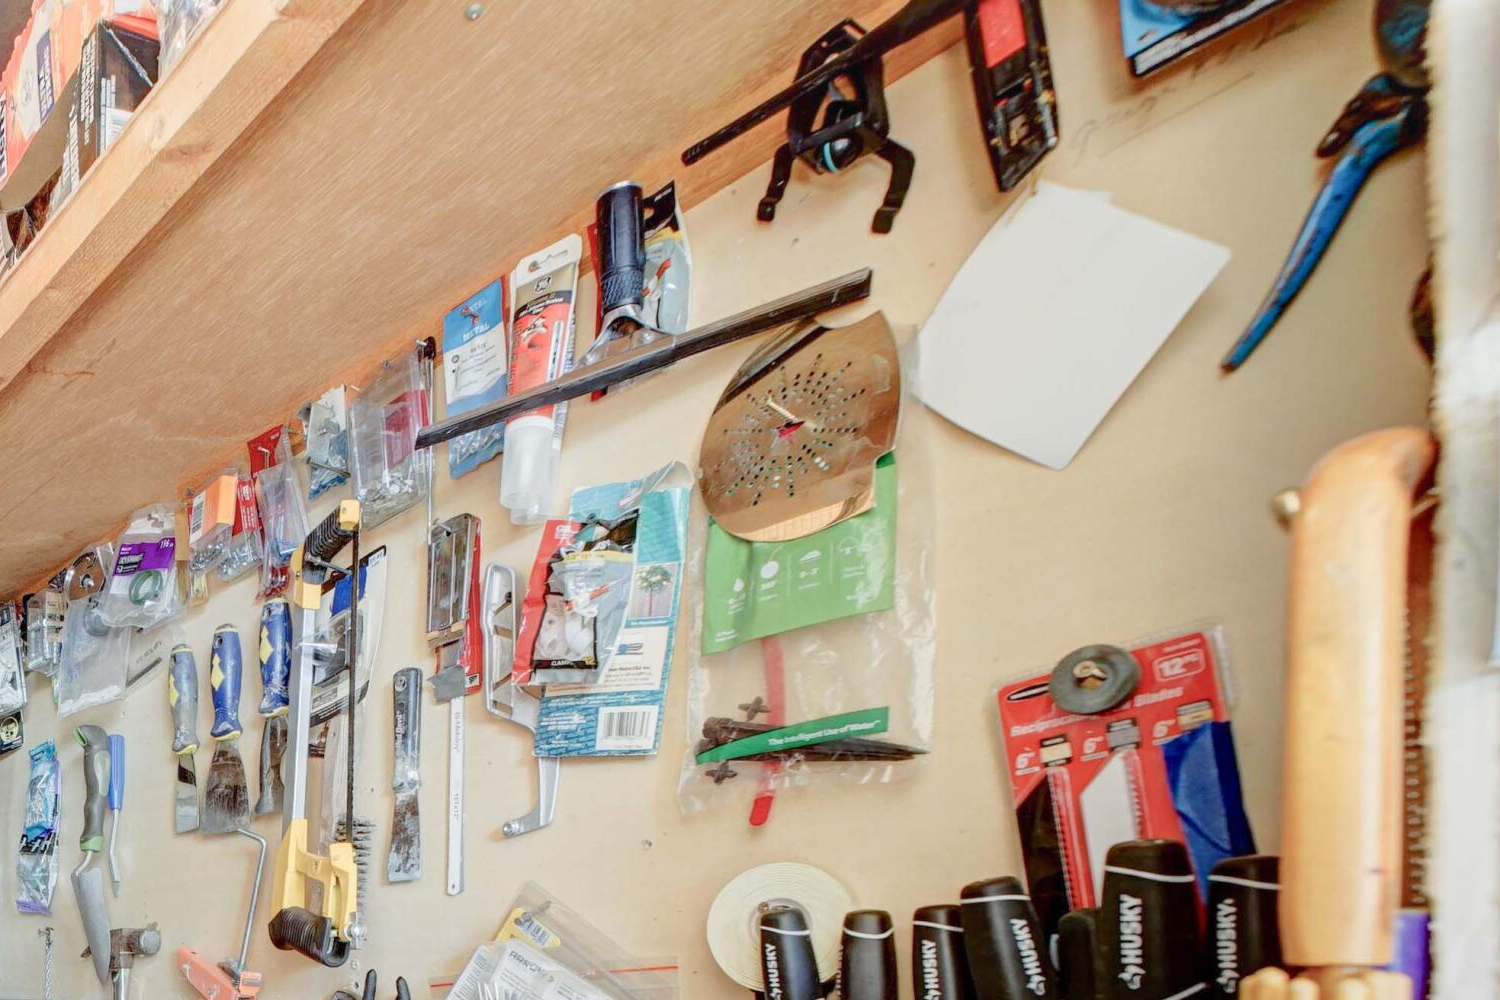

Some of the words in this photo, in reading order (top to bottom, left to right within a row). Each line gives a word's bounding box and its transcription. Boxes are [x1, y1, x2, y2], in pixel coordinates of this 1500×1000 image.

[1008, 917, 1044, 982] HUSKY
[1119, 894, 1143, 964] HUSKY
[1216, 900, 1237, 976] HUSKY
[763, 942, 782, 990] HUSKY
[921, 939, 938, 994] HUSKY
